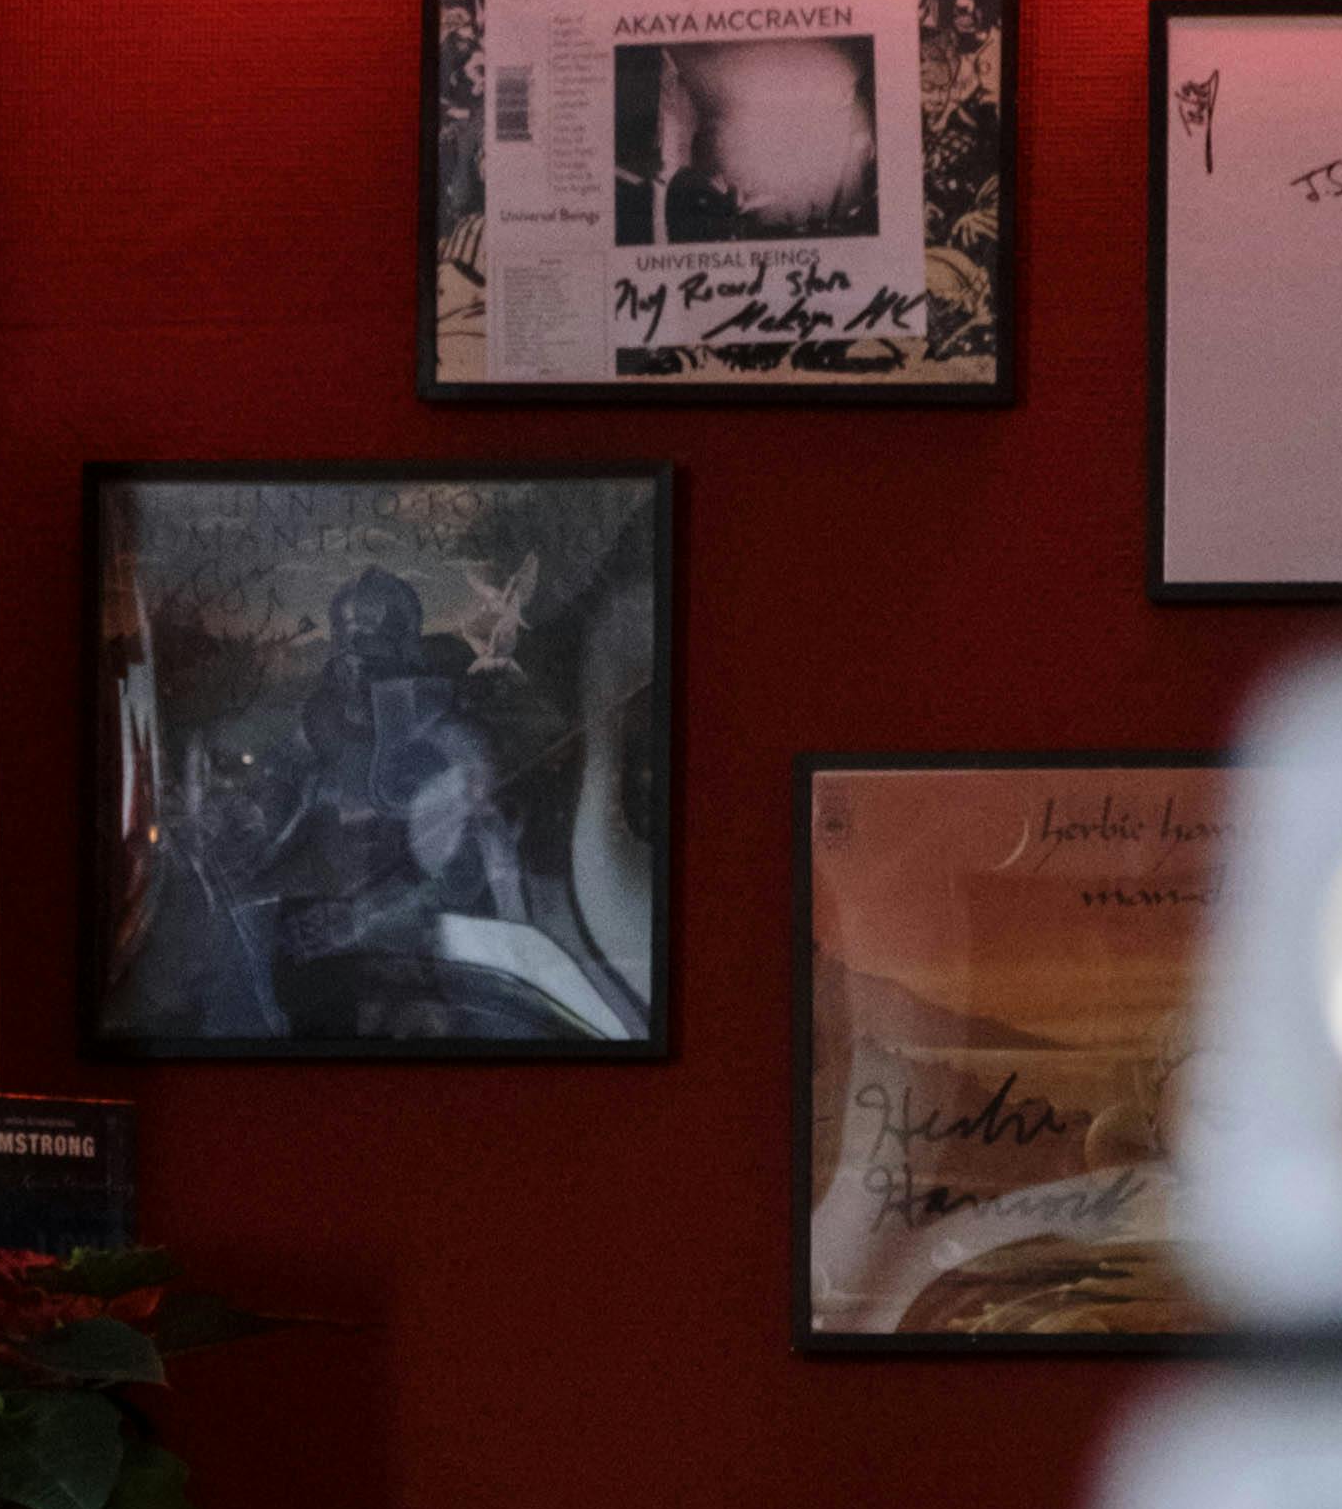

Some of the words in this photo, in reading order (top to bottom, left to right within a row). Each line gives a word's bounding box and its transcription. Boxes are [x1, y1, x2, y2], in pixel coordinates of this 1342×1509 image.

[613, 12, 699, 36] AKAYA
[705, 5, 854, 33] MCCRAVEN
[635, 250, 746, 272] UNIVERSAL
[1033, 795, 1145, 873] herbie
